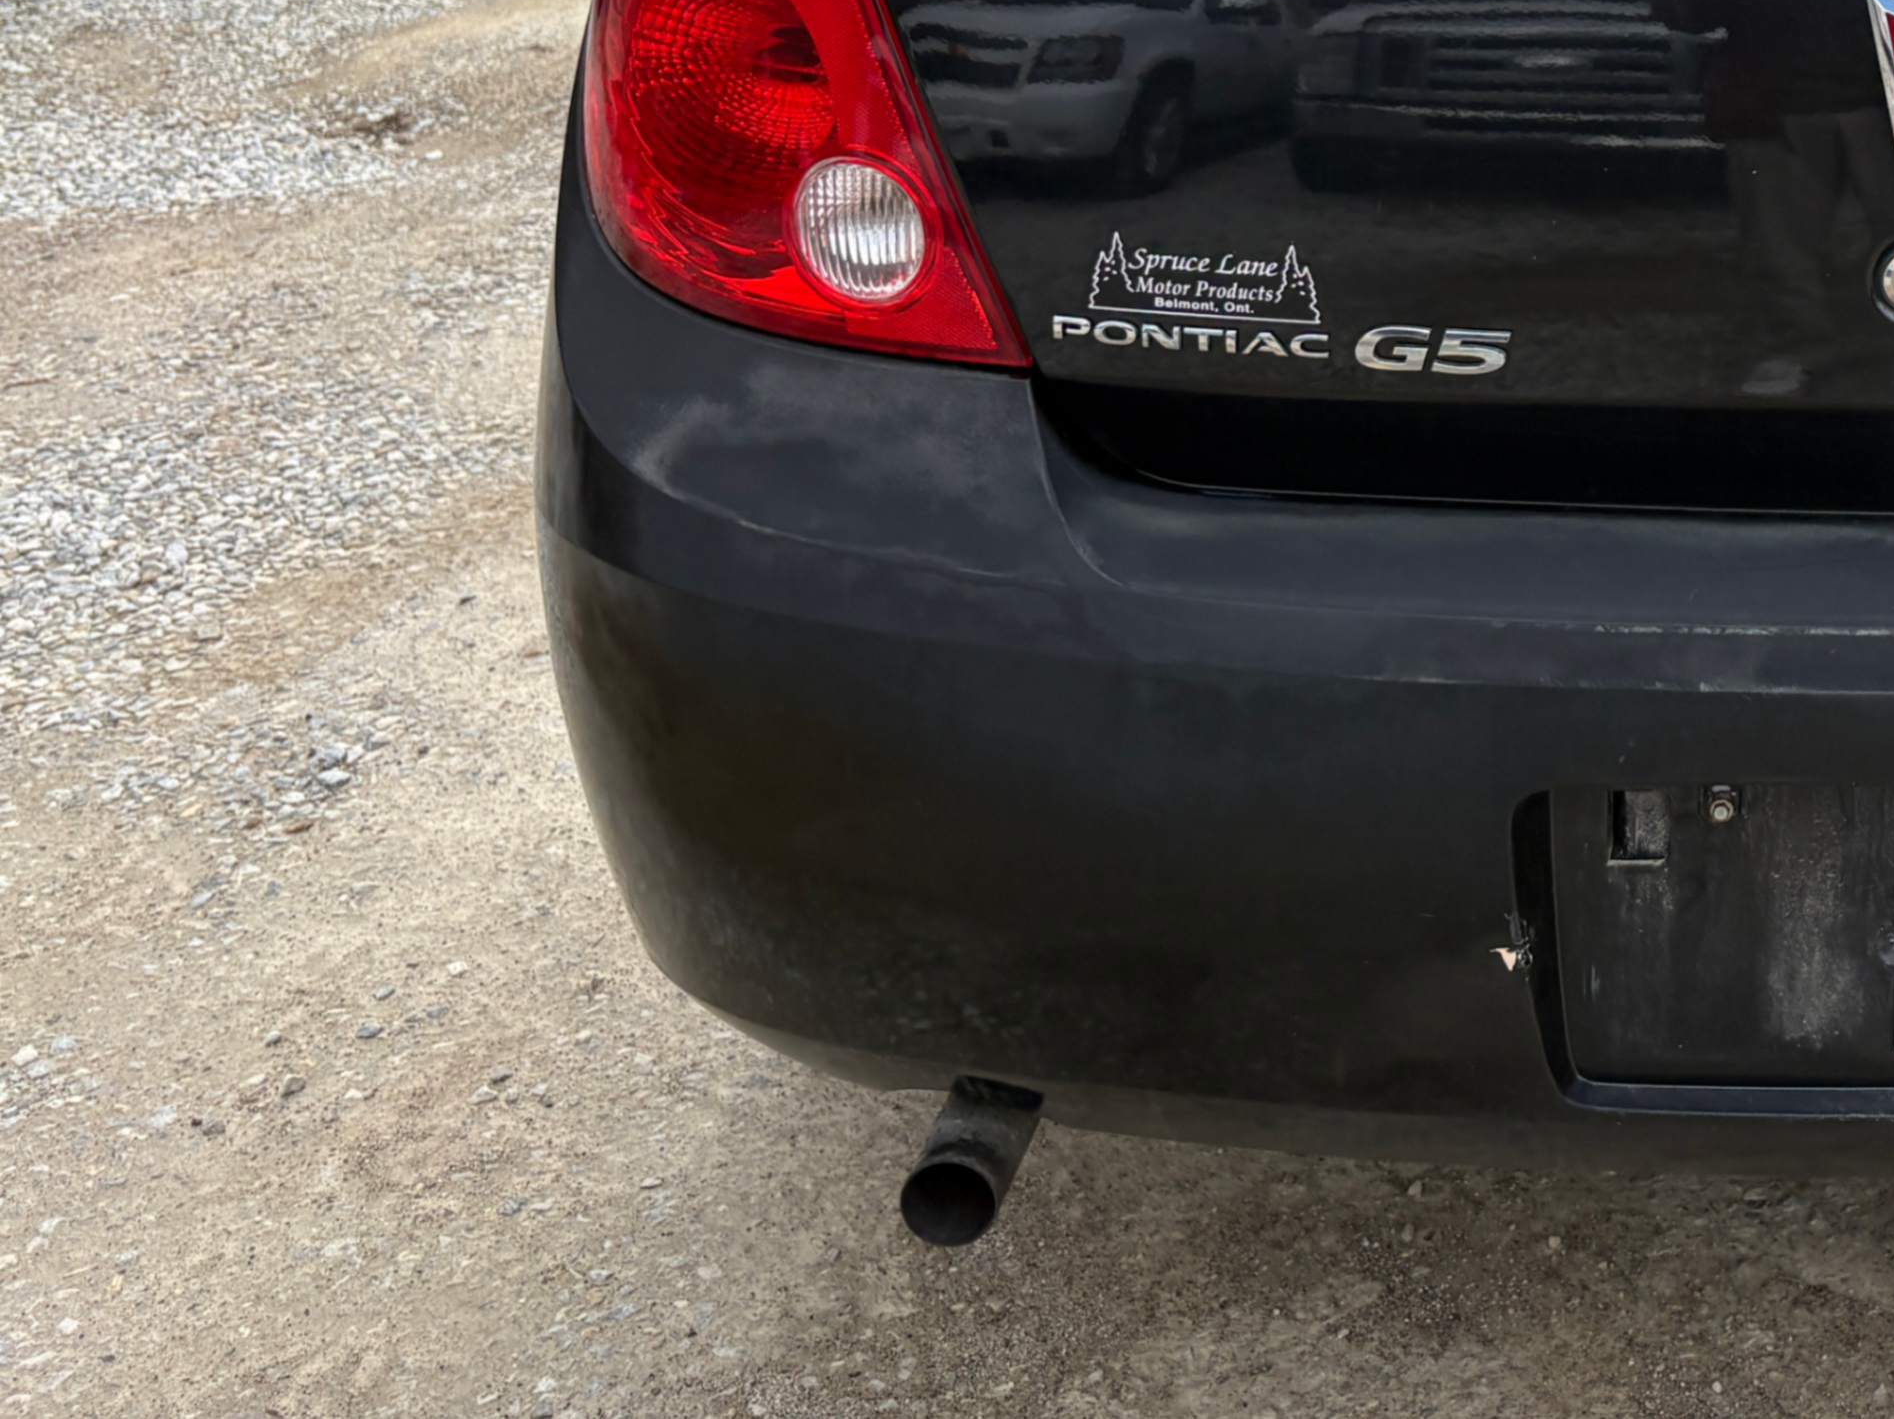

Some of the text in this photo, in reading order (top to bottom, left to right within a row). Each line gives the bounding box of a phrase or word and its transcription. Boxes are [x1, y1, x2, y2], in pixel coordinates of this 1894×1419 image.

[1127, 247, 1279, 277] Spruce Lane
[1135, 276, 1275, 302] Motor Products
[1154, 296, 1255, 314] Belmont, Ont.
[1052, 315, 1513, 376] PONTIAC G5
